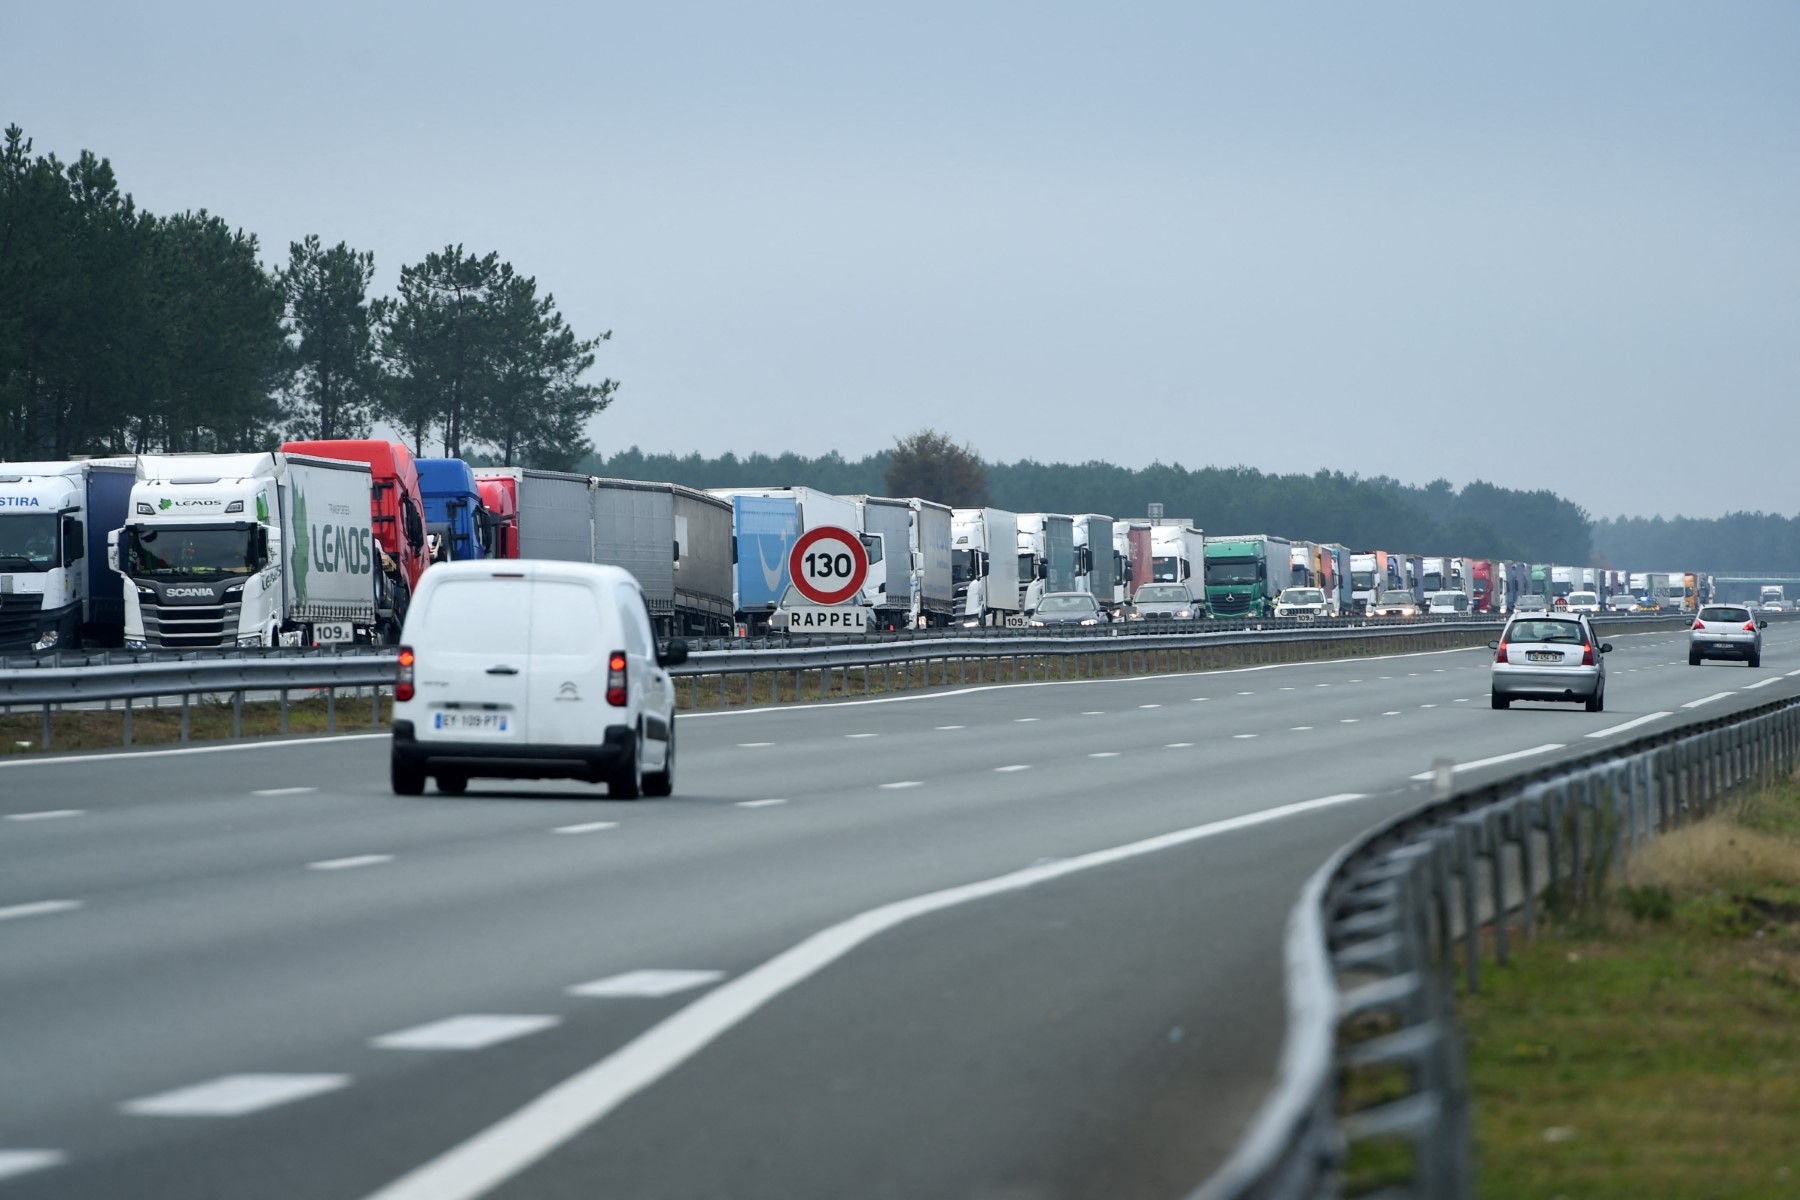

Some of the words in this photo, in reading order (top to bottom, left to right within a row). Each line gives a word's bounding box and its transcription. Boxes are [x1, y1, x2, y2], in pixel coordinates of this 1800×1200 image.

[312, 523, 371, 574] LEMOS
[805, 553, 851, 577] 130
[166, 588, 214, 597] SCANIA
[791, 612, 864, 627] RAPPEL
